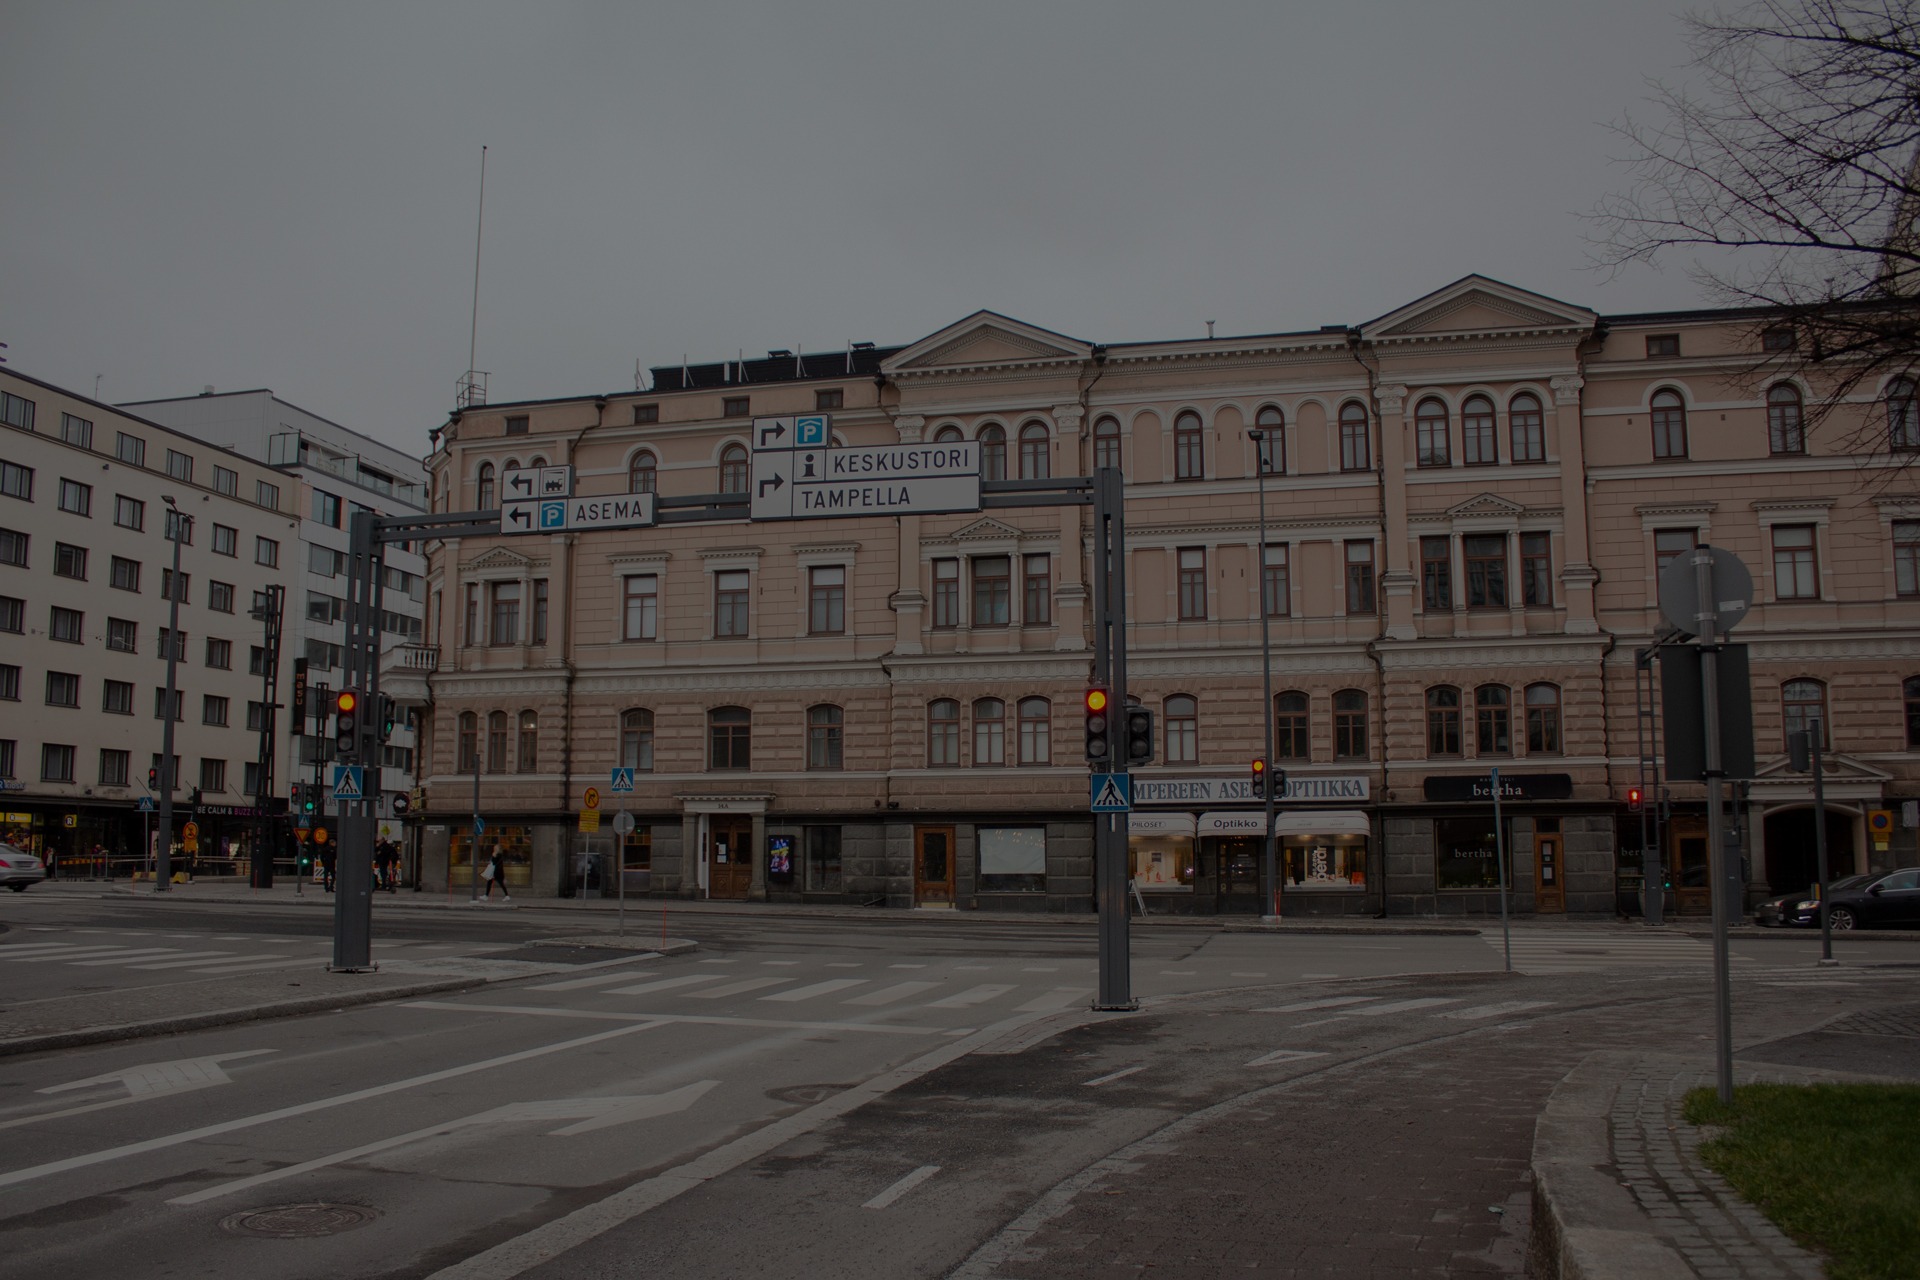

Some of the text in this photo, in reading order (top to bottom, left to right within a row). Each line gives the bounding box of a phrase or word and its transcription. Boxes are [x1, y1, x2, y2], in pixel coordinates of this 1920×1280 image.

[803, 425, 817, 442] P
[834, 449, 969, 473] KESKUSTORI
[801, 486, 911, 509] TAMPELLA
[546, 500, 643, 526] P ASEMA
[1134, 782, 1211, 800] MPEREEN
[1472, 783, 1523, 796] bertha
[197, 806, 206, 814] BE
[207, 806, 226, 815] CALM
[1214, 819, 1258, 829] Optikko
[1454, 848, 1493, 858] bertha
[1621, 847, 1646, 857] bert
